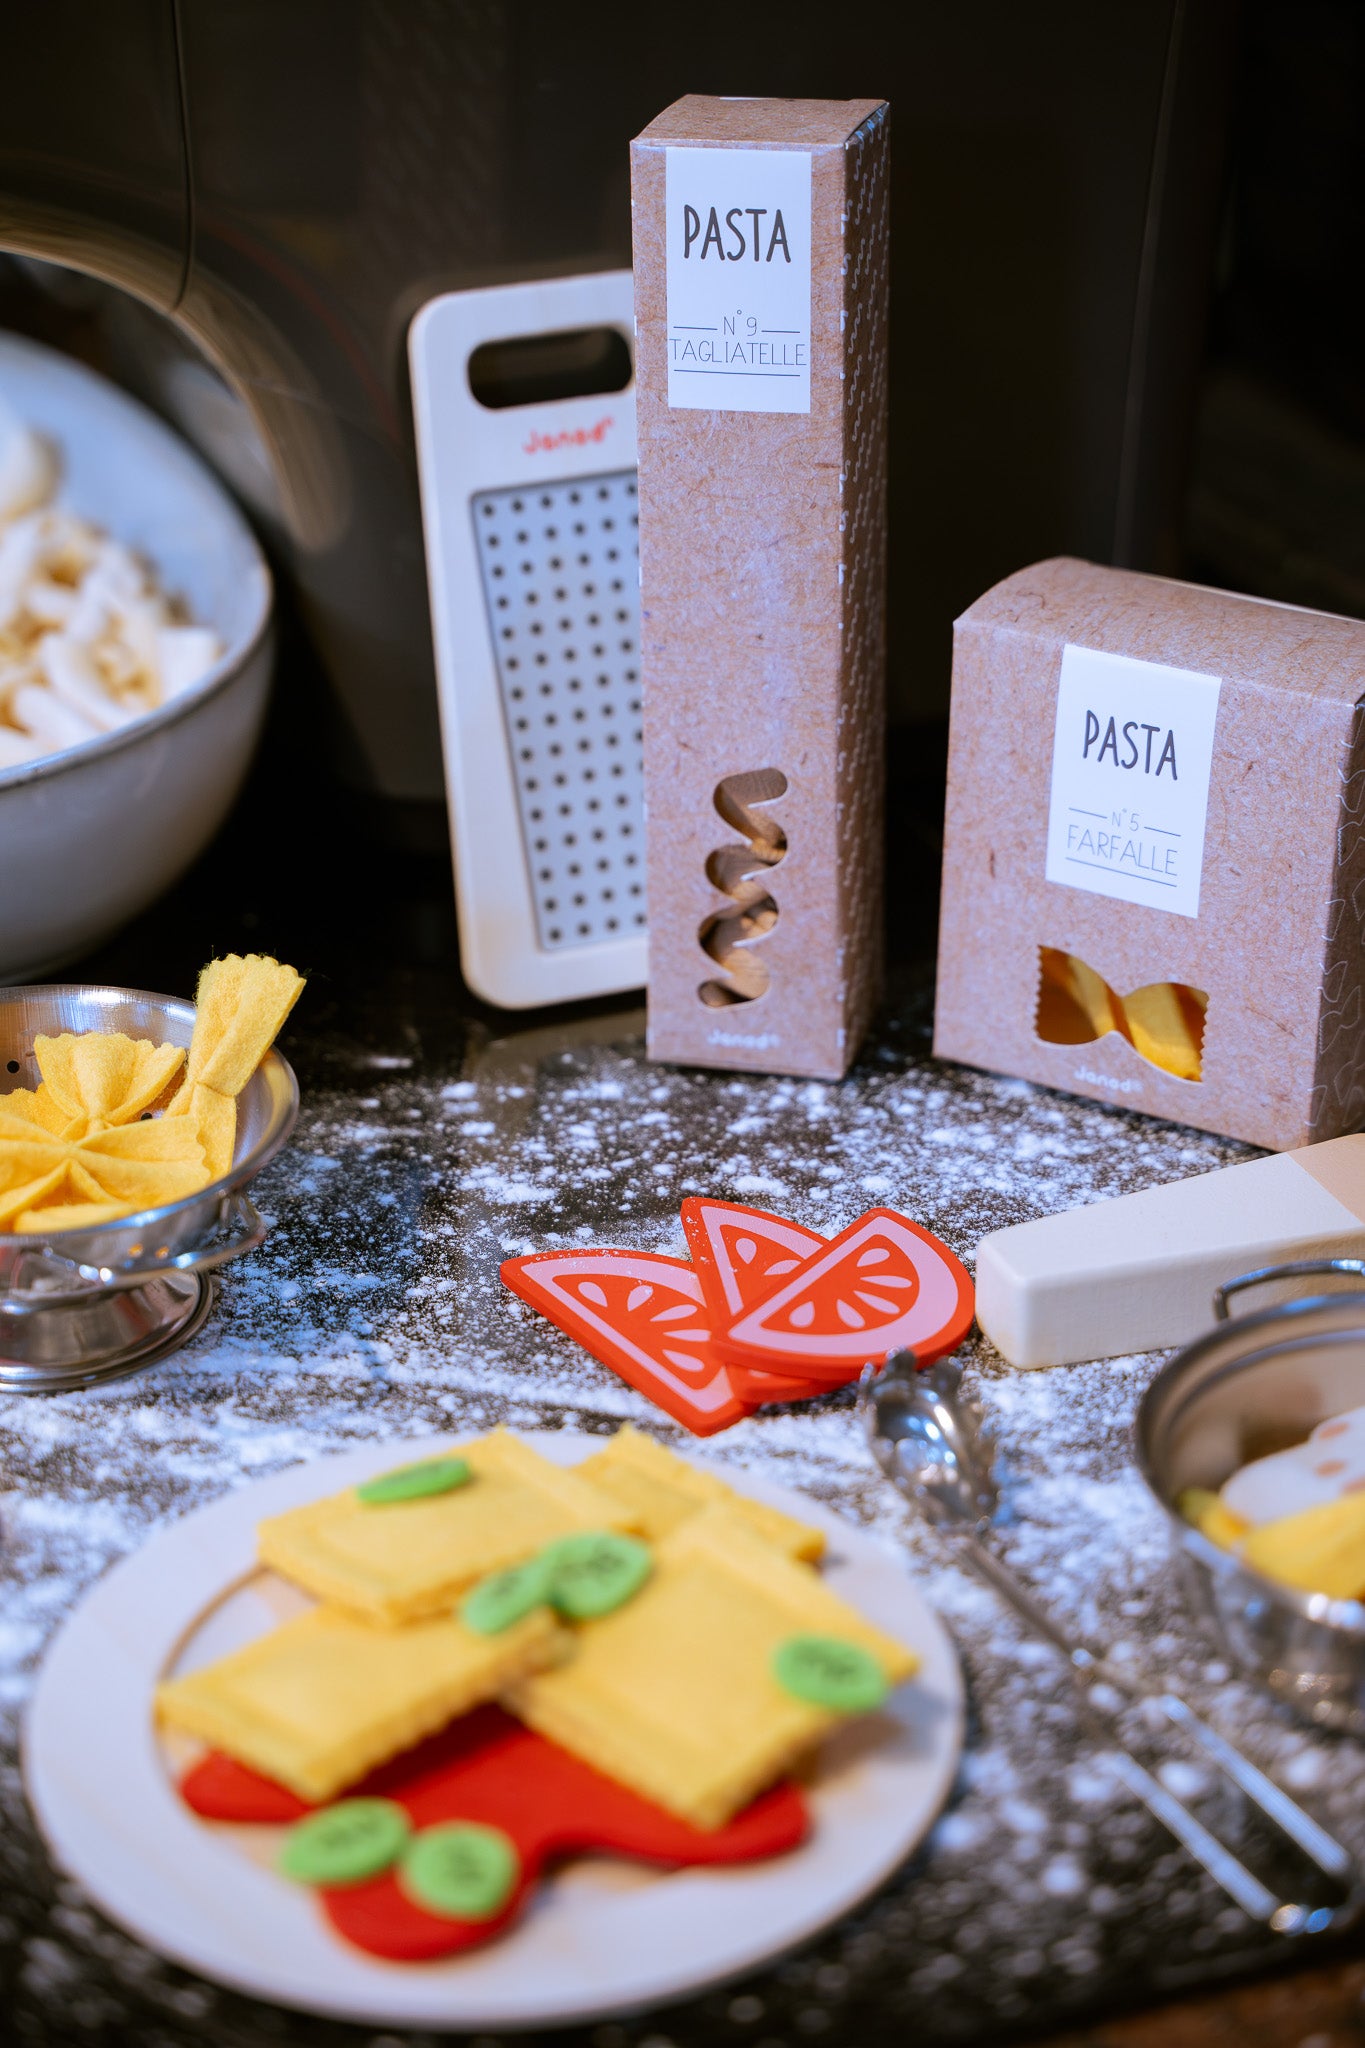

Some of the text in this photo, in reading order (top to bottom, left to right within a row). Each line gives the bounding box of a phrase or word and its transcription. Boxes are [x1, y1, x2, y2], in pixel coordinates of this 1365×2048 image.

[683, 204, 791, 263] PASTA
[668, 338, 807, 366] TAGLIATELLE
[1082, 709, 1178, 781] PASTA
[1066, 824, 1178, 877] FARFALLE
